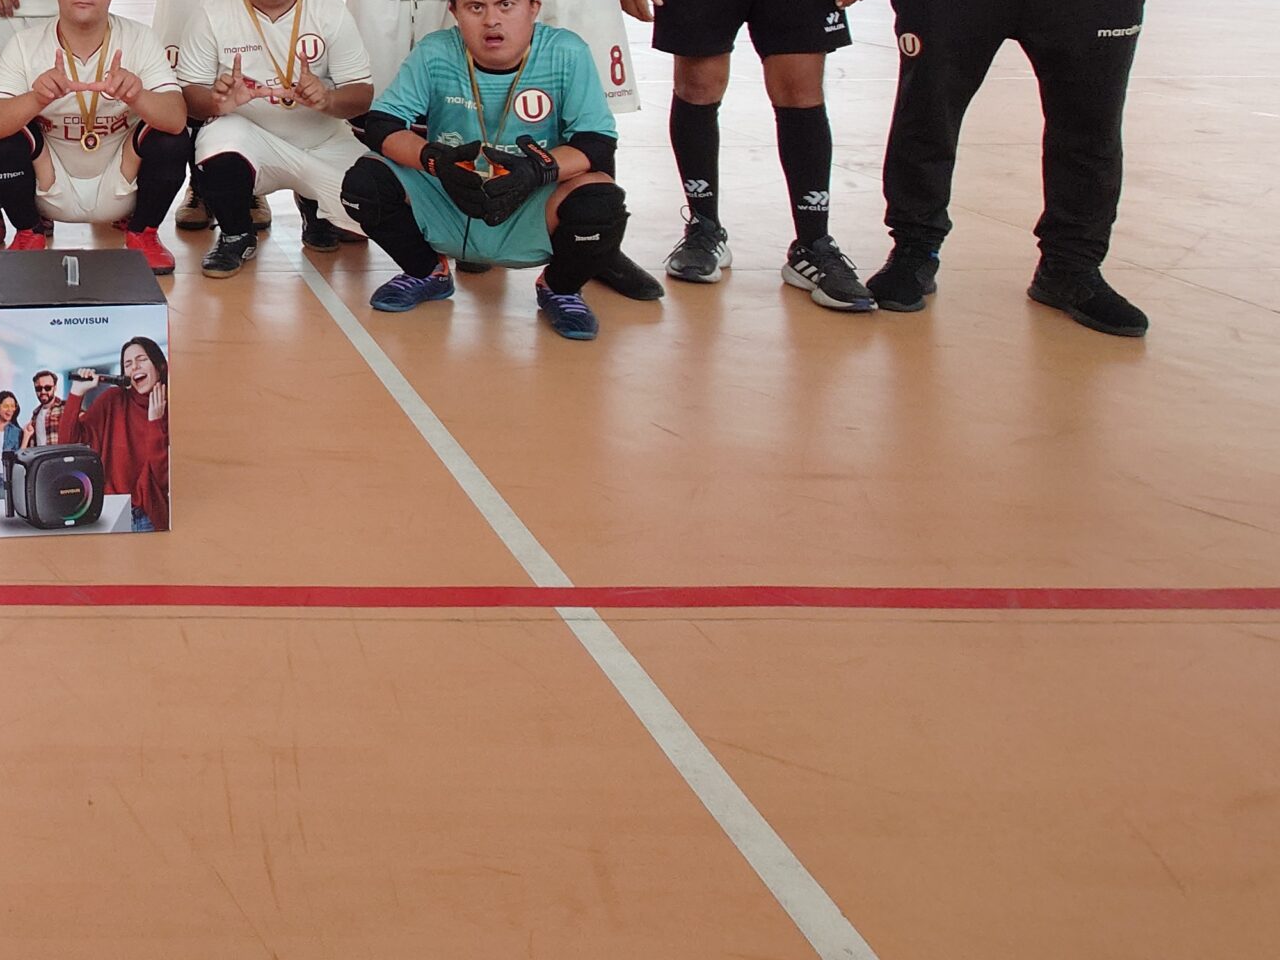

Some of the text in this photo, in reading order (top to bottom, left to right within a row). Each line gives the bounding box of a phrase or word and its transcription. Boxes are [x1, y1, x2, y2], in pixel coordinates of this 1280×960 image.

[224, 44, 263, 55] marathon
[610, 45, 626, 86] 8
[64, 316, 109, 325] MOVISUN
